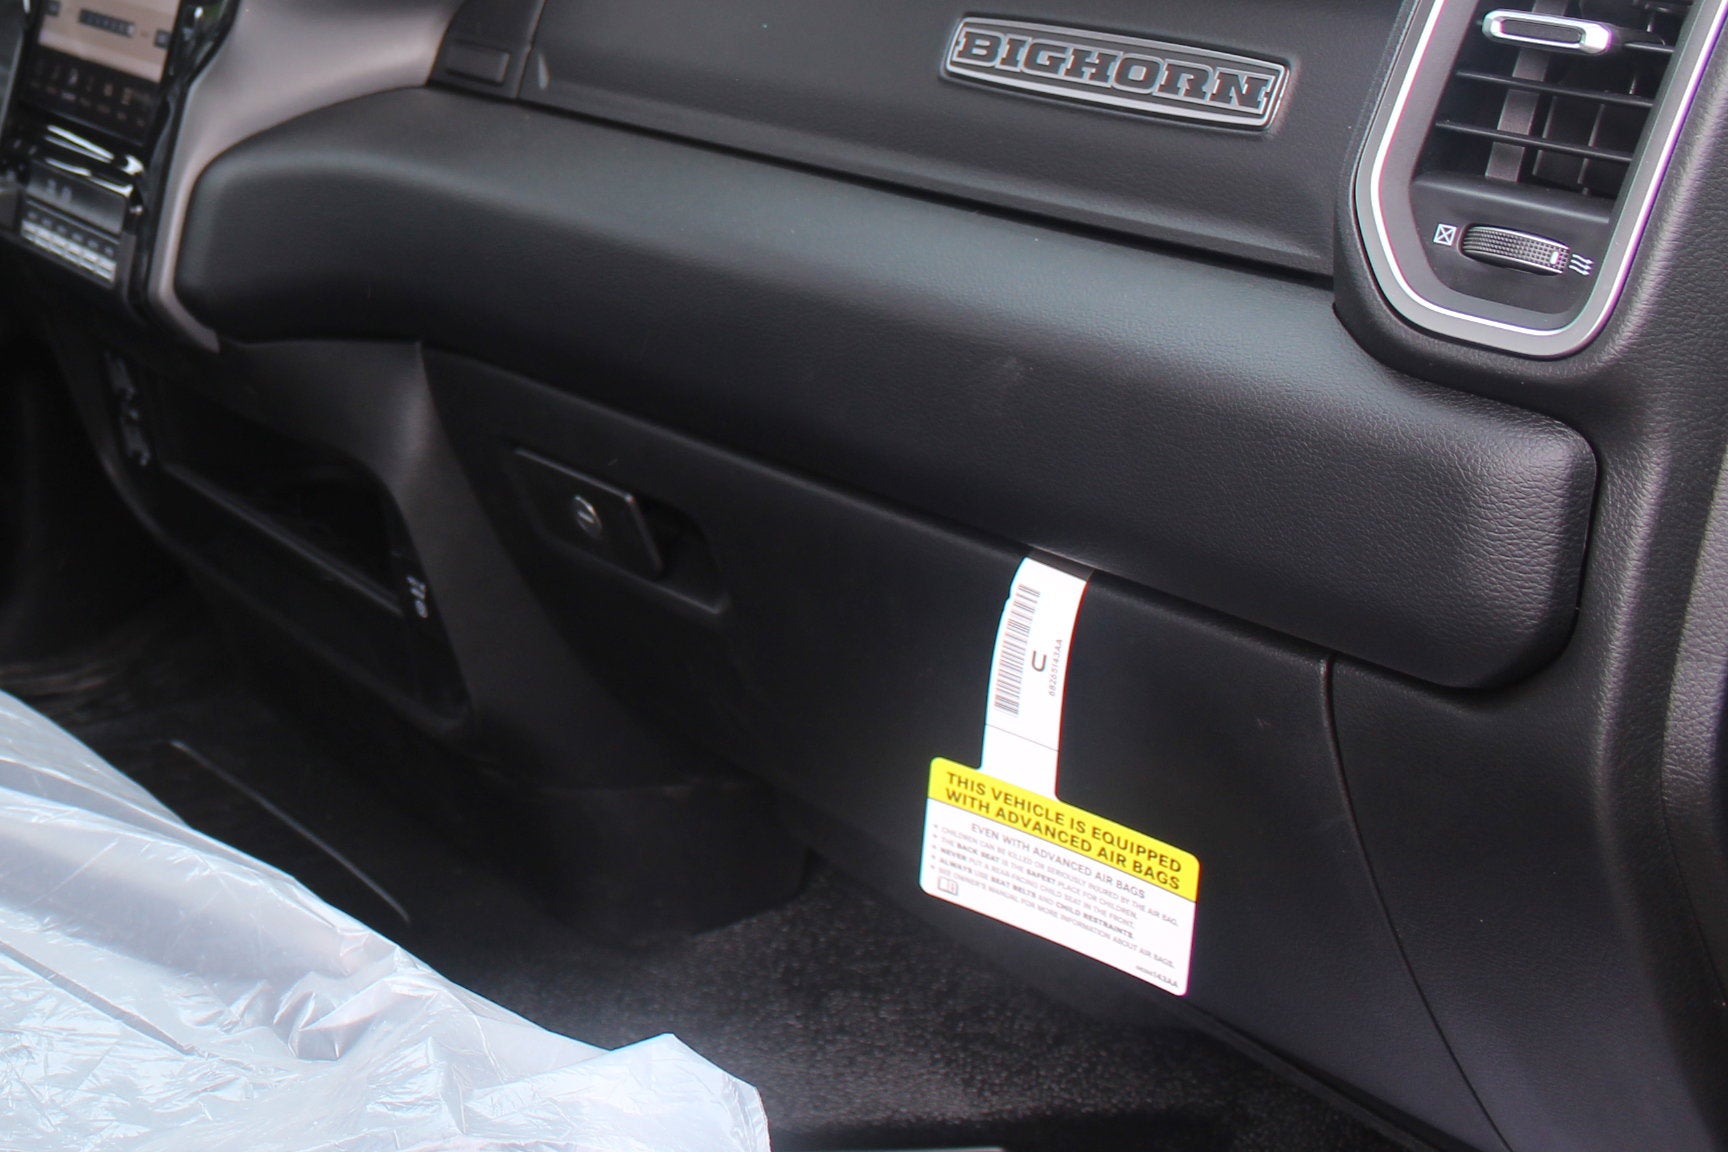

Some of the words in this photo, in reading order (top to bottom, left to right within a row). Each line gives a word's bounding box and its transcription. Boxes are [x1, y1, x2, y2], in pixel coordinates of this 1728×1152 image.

[951, 28, 1276, 115] BIGHORN
[945, 786, 988, 814] WITH
[995, 805, 1092, 853] ADVANCED
[1096, 845, 1126, 867] AIR
[1132, 859, 1180, 890] BAGS
[946, 770, 985, 796] THIS
[990, 786, 1064, 826] VEHICLE
[1069, 816, 1086, 835] IS
[1091, 825, 1181, 873] EQUIPPED
[940, 845, 966, 861] NEVER
[956, 841, 977, 855] BACK
[980, 850, 999, 863] SEAT
[1026, 868, 1054, 884] SAFEST
[1057, 880, 1080, 894] PLACE
[1083, 890, 1096, 901] FOR
[971, 822, 998, 840] EVEN
[1002, 834, 1029, 851] WITH
[1033, 845, 1091, 876] ADVANCED
[1095, 870, 1112, 885] AIR
[1115, 879, 1145, 899] BAGS
[939, 855, 971, 874] ALWAYS
[991, 875, 1009, 888] SEAT
[1012, 883, 1036, 898] BELTS
[1055, 901, 1080, 916] CHILD
[1132, 900, 1145, 911] THE
[1147, 907, 1159, 917] AIR
[1112, 935, 1137, 951] ABOUT
[1139, 947, 1151, 957] AIR
